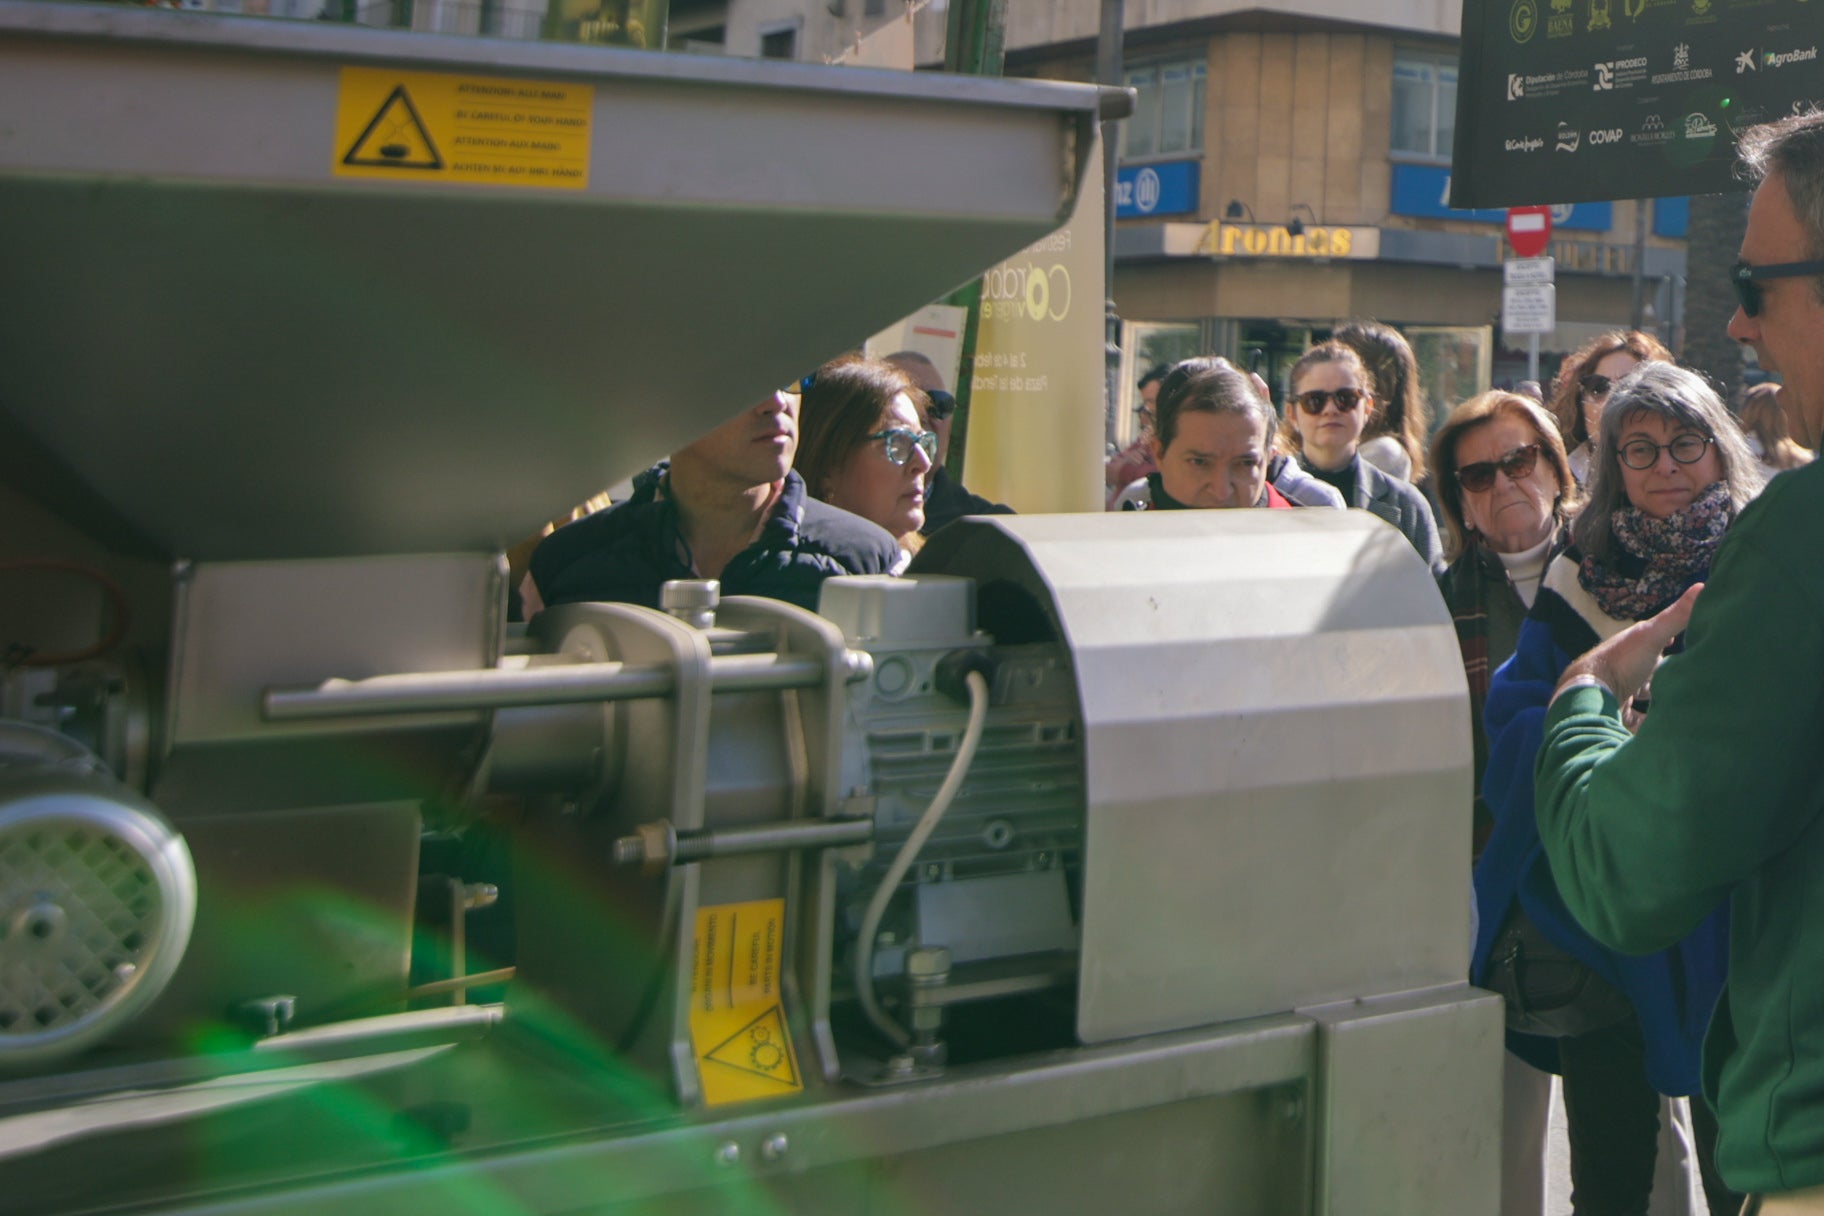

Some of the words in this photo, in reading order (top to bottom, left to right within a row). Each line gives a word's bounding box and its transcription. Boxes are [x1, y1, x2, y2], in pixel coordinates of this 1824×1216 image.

[1768, 46, 1818, 68] AgroBank
[471, 112, 511, 122] CAREFUL
[1589, 129, 1623, 145] COVAP
